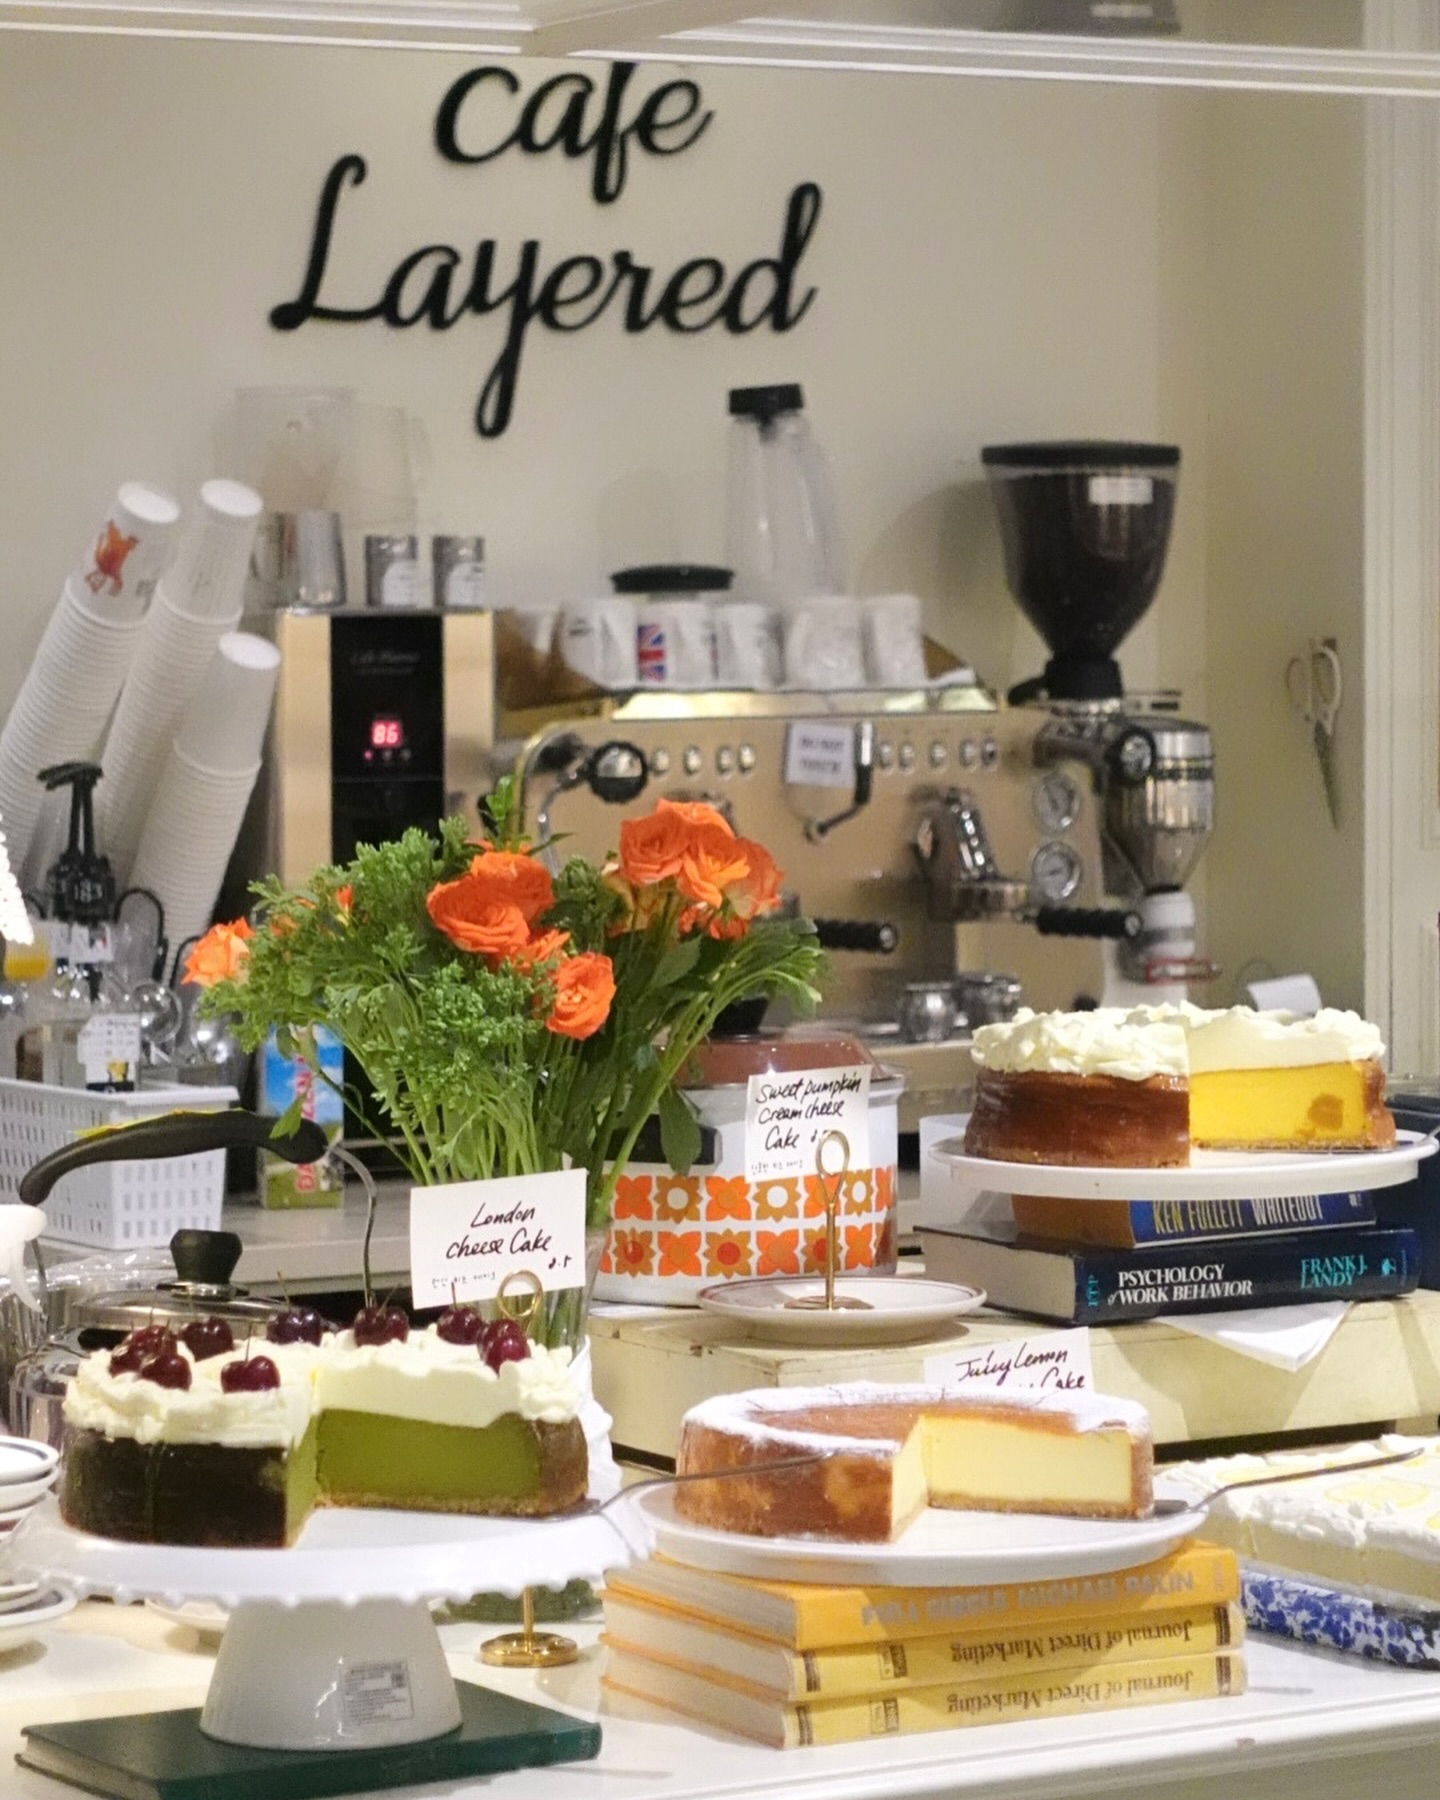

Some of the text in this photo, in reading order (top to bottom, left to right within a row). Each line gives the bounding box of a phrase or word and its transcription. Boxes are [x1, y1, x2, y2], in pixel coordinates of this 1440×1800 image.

[270, 154, 822, 440] Layered
[372, 720, 400, 745] 86
[755, 1071, 862, 1104] Sweet pumpkin
[765, 1125, 800, 1151] Cake
[470, 1200, 536, 1228] London
[1153, 1200, 1184, 1234] KEN
[446, 1227, 552, 1259] cheese Cake
[1118, 1263, 1225, 1288] PSYCHOLOGY
[1300, 1254, 1368, 1276] FRANK J.
[1117, 1286, 1169, 1306] WORK
[1172, 1280, 1253, 1302] BEHAVIOR
[1300, 1271, 1357, 1289] LANDY
[1013, 1342, 1068, 1368] Lemon
[951, 1619, 1193, 1665] Journal of Direct Marketing
[947, 1671, 1193, 1715] Journal of Direct Marketing
